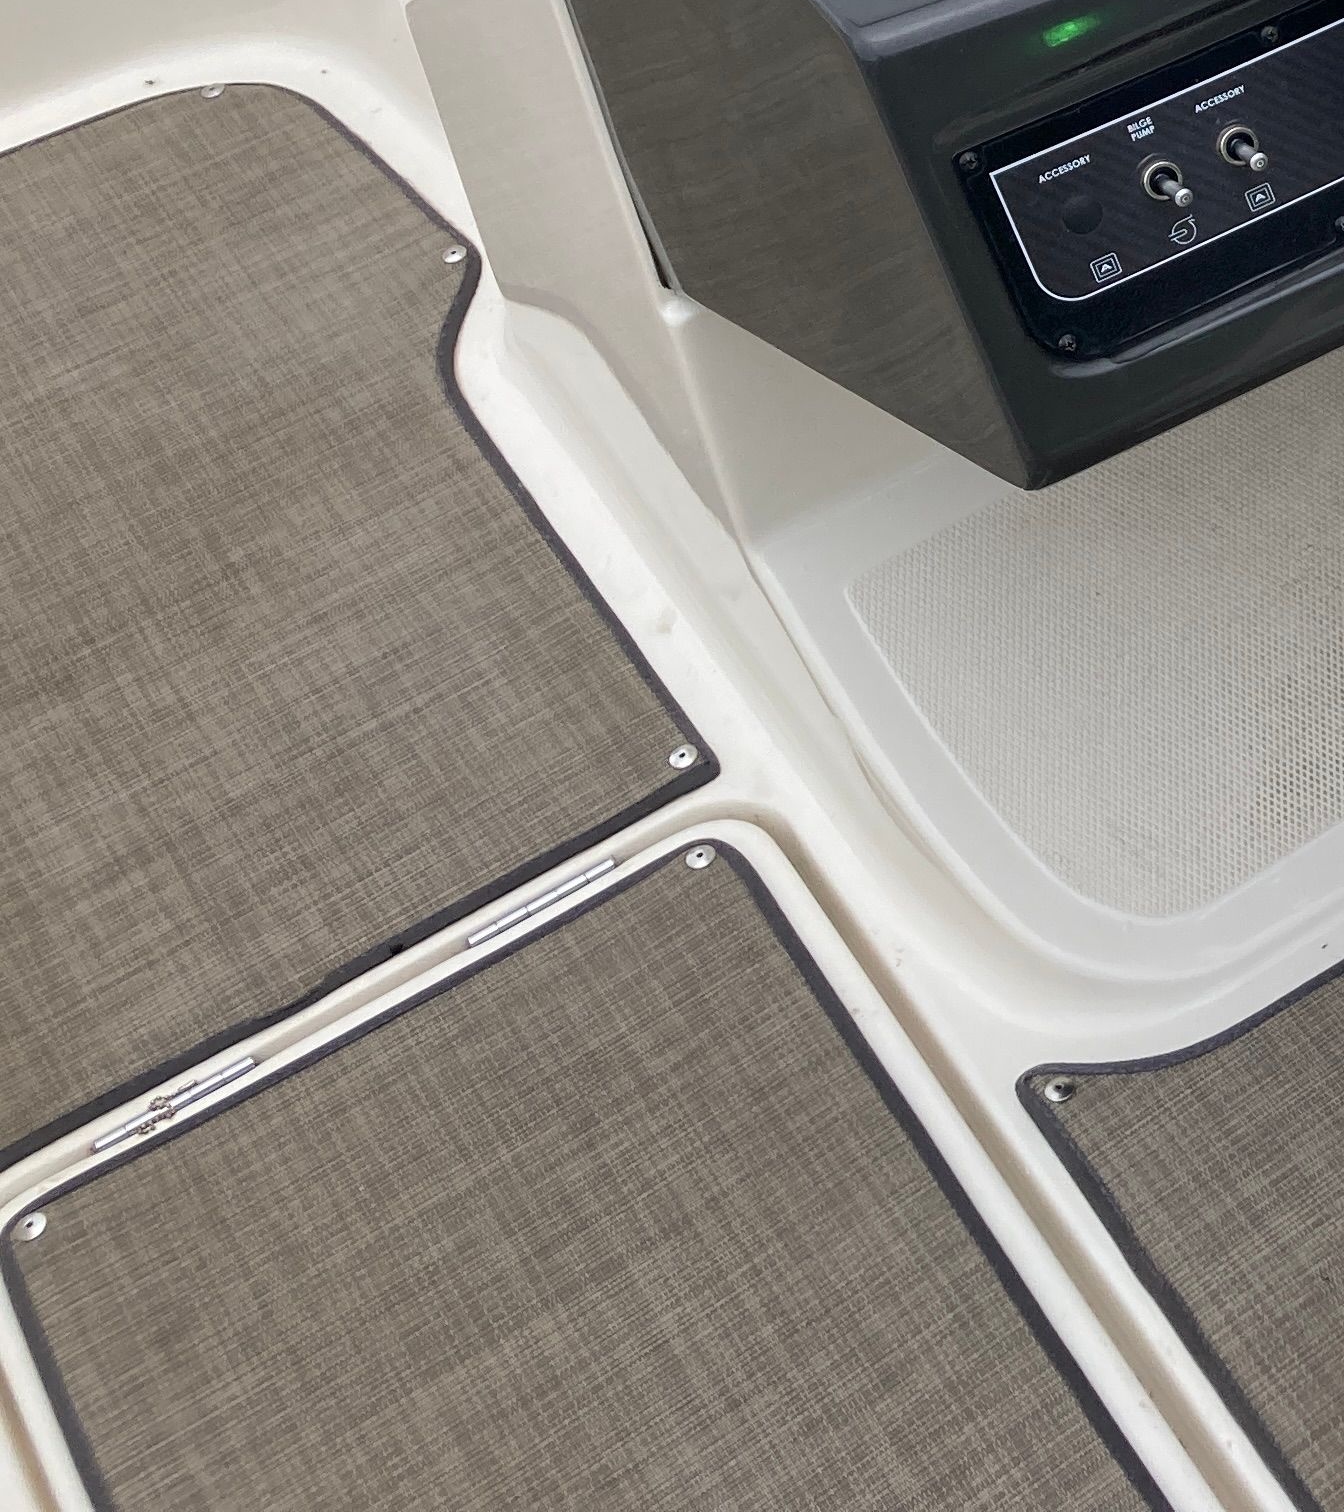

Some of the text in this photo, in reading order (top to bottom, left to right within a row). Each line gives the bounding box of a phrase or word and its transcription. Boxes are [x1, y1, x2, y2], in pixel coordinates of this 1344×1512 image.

[1195, 85, 1245, 114] ACCESSORY
[1127, 116, 1153, 133] BILGE
[1131, 125, 1155, 142] PUMP
[1038, 154, 1091, 184] ACCESSORY
